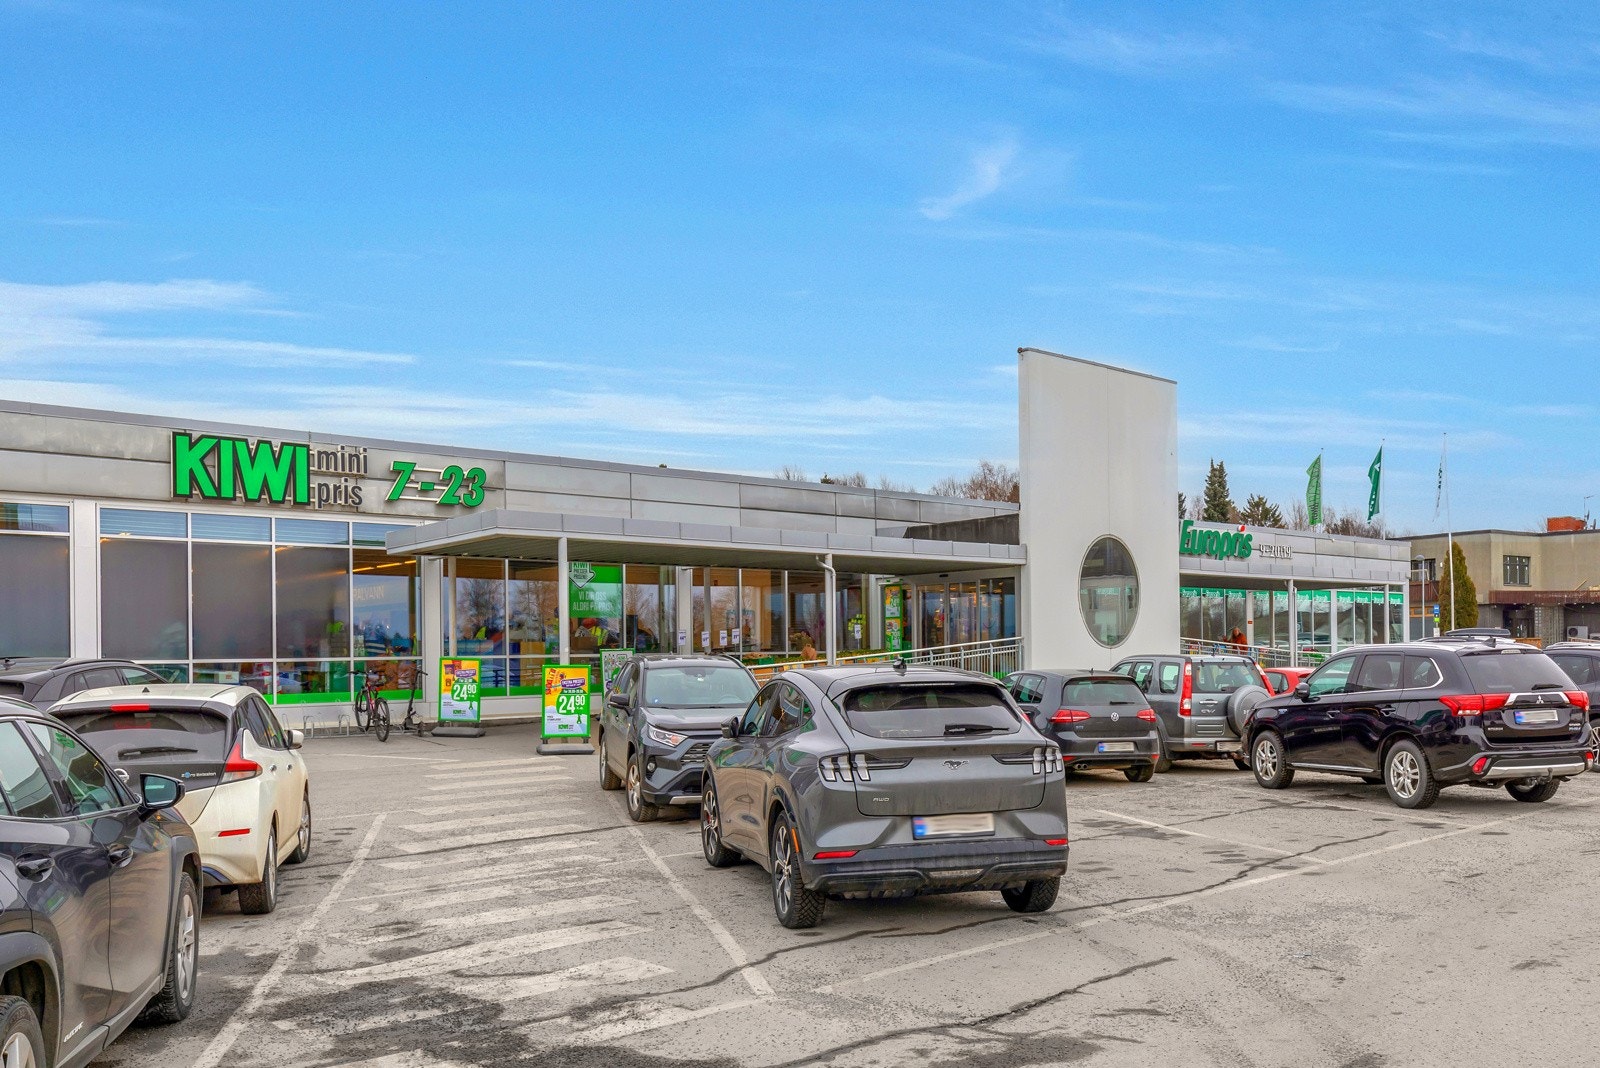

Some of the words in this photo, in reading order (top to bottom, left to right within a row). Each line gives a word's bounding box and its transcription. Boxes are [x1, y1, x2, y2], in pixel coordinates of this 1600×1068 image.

[172, 432, 311, 506] KIWI
[316, 445, 368, 474] mini
[316, 477, 363, 508] pris
[1179, 520, 1253, 560] Europris
